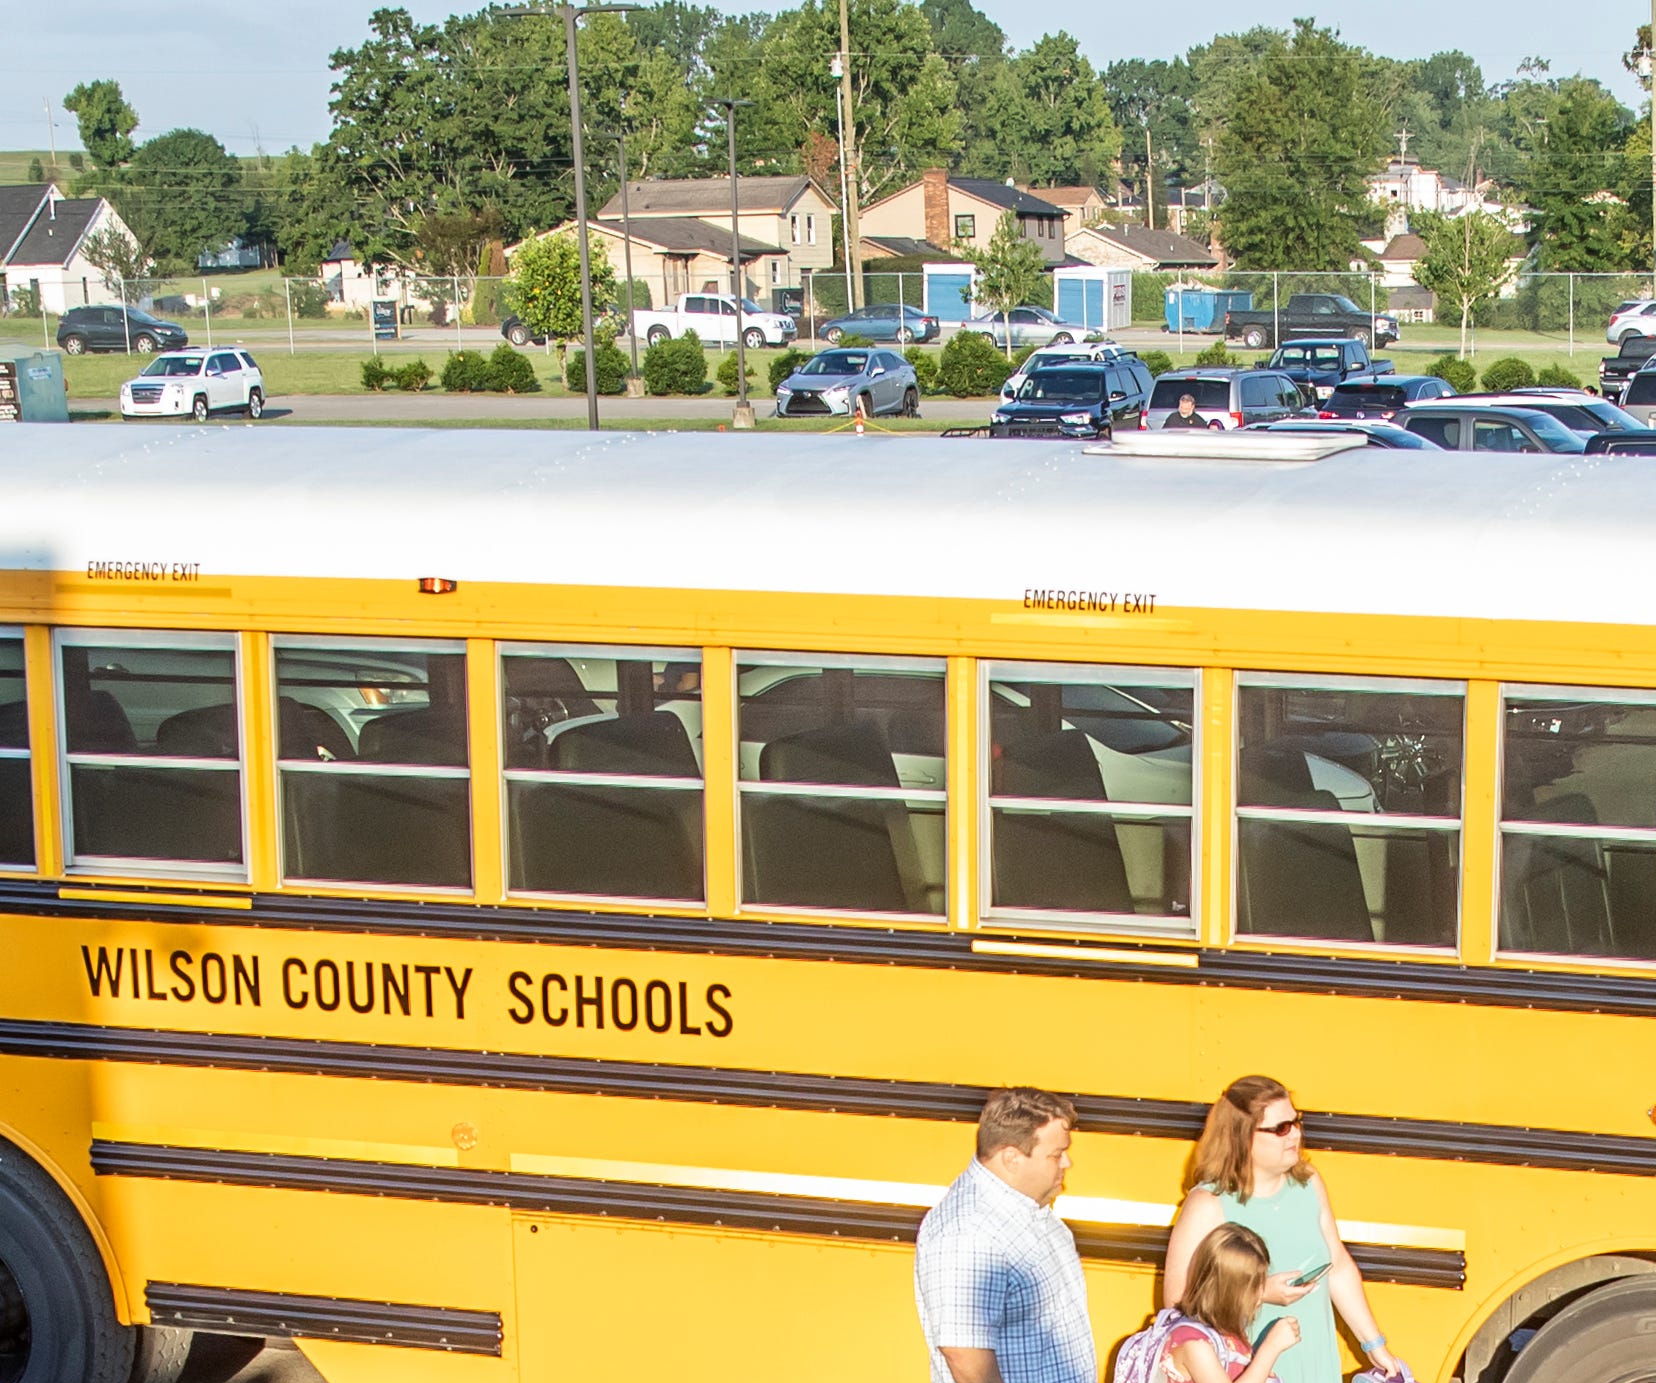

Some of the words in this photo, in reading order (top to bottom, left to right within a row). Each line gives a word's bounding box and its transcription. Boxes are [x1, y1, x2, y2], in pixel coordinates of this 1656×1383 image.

[87, 560, 167, 581] EMERGENCY
[172, 562, 200, 581] EXIT
[1024, 589, 1118, 612] EMERGENCY
[1123, 593, 1156, 613] EXIT
[80, 945, 261, 1007] WILSON
[282, 957, 473, 1020] COUNTY
[507, 970, 734, 1038] SCHOOLS
